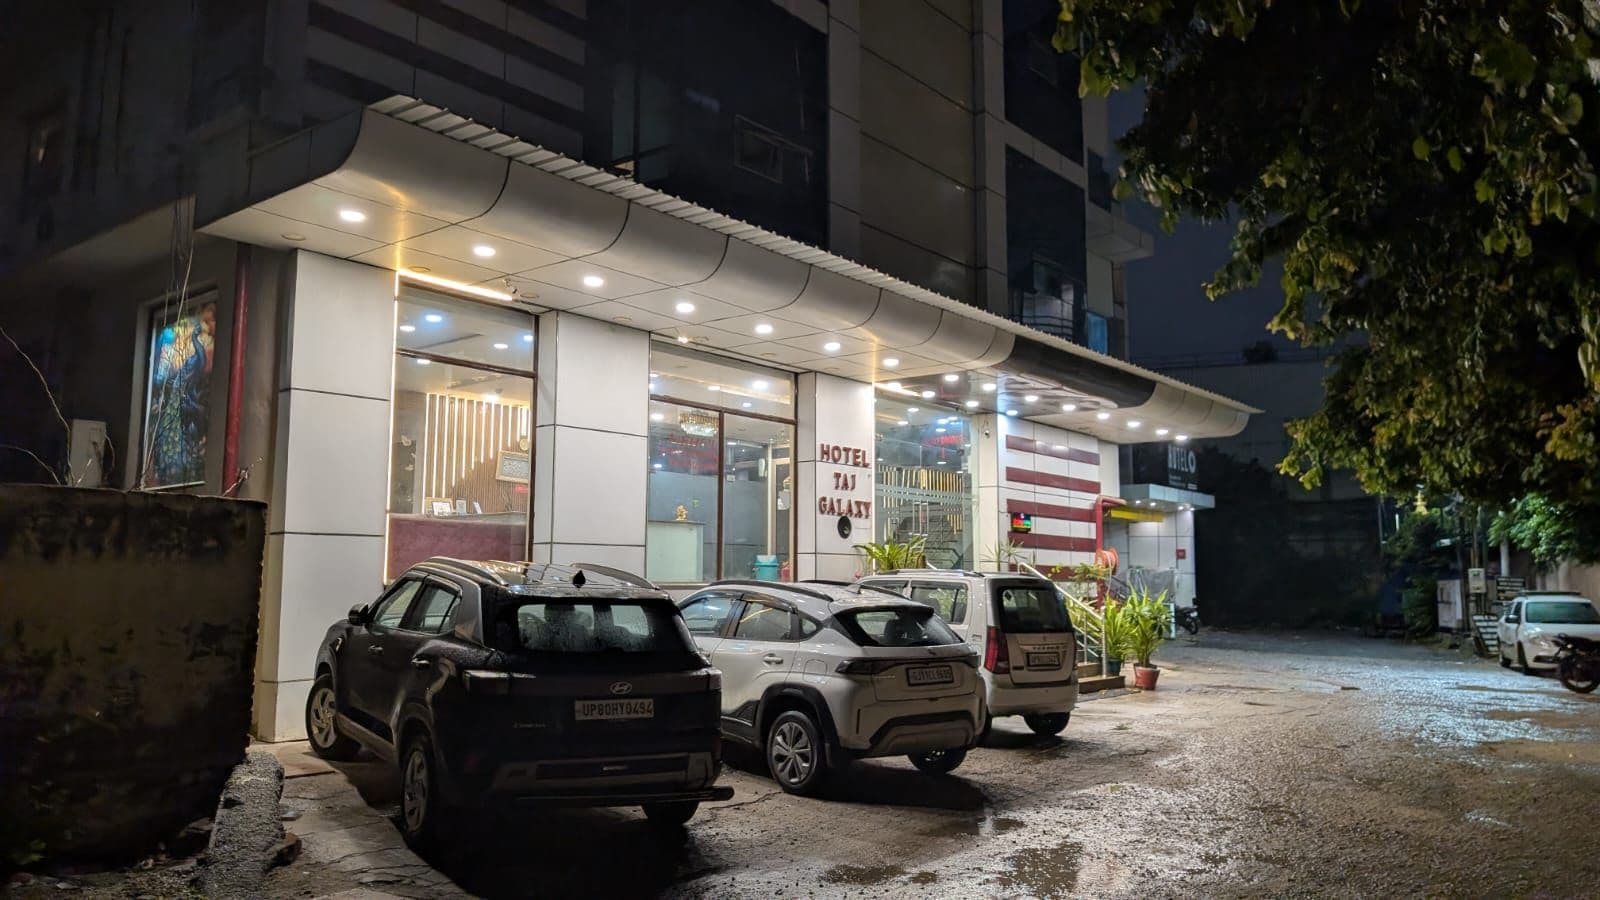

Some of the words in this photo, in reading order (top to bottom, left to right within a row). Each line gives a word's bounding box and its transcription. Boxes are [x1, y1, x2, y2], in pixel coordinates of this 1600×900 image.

[820, 443, 870, 468] HOTEL
[833, 472, 856, 491] TAJ
[818, 496, 871, 519] GALAXY
